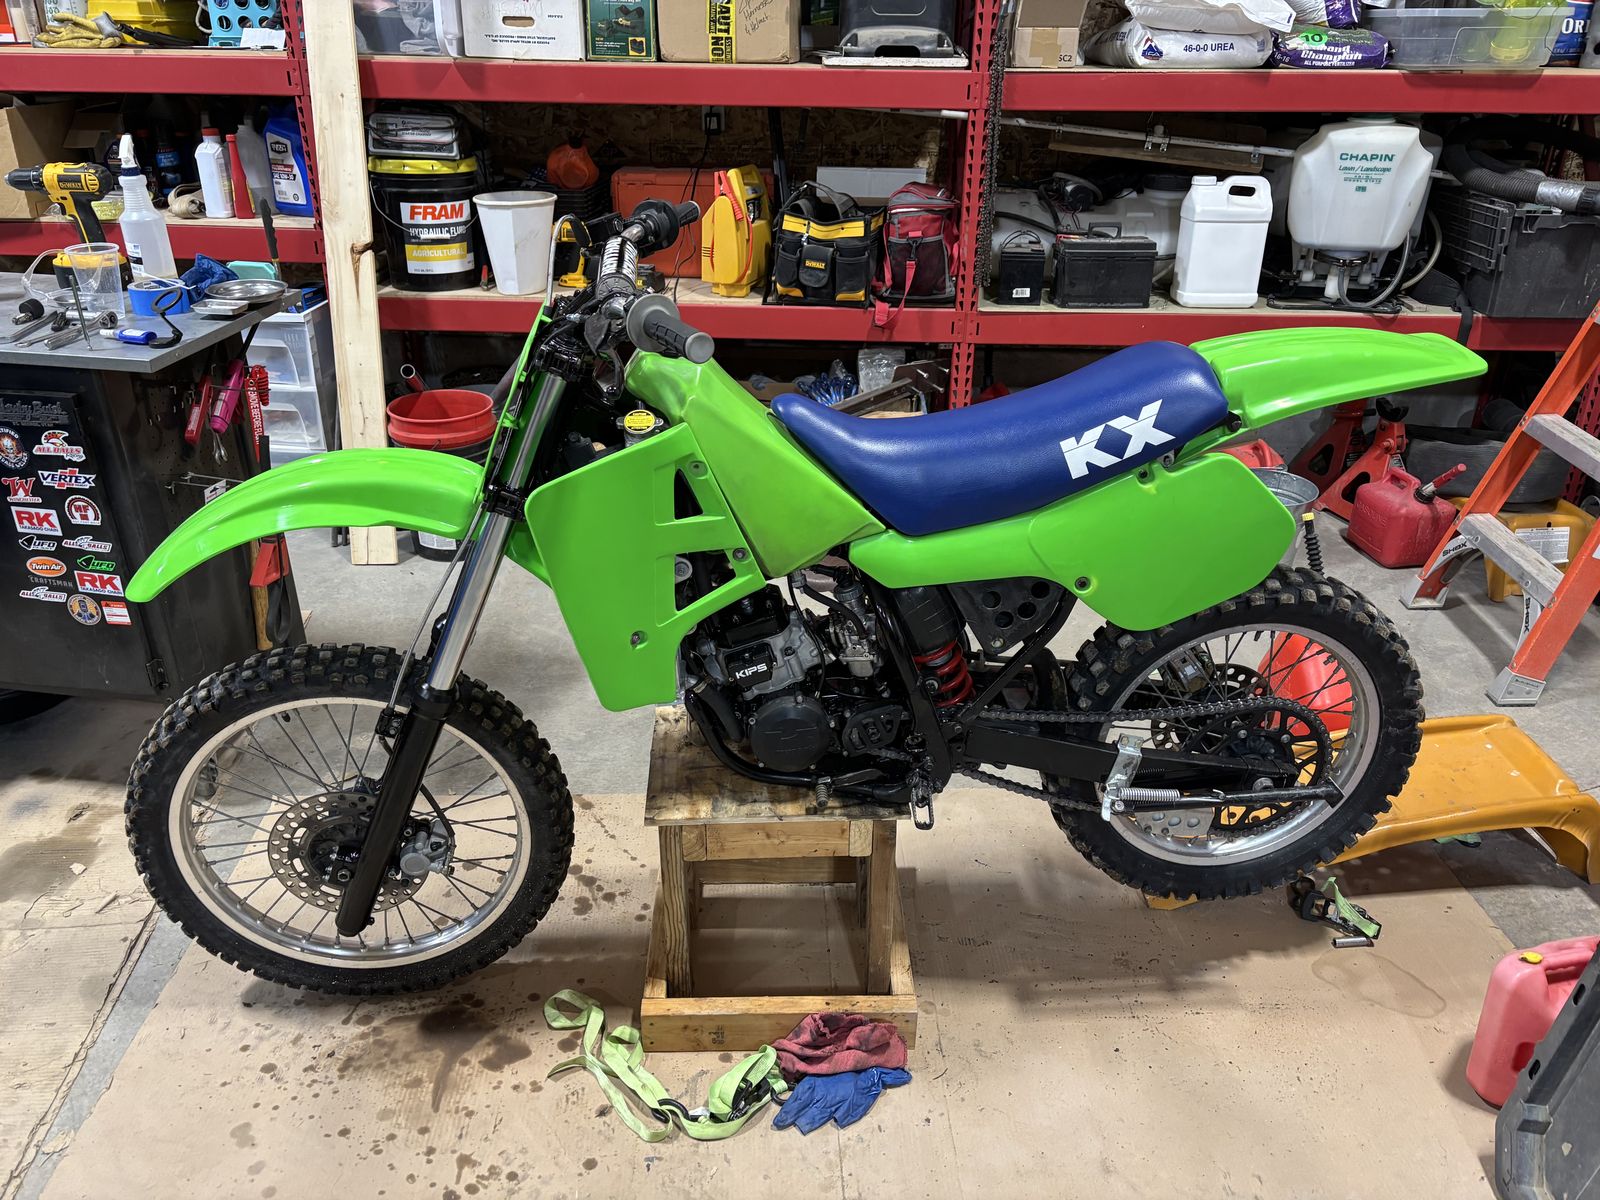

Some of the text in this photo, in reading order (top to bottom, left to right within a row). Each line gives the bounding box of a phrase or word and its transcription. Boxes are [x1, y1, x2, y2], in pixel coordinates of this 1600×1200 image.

[1300, 33, 1324, 43] 10
[1183, 42, 1235, 53] 46-0-0 UREA
[1058, 54, 1072, 62] SC2
[1339, 152, 1394, 162] CHAPIN
[1360, 165, 1392, 174] Landscape
[409, 203, 464, 221] FRAM
[409, 227, 449, 237] HYDRAULIC
[412, 247, 465, 257] AGRICULTURAL
[1060, 399, 1177, 480] KX
[40, 472, 94, 485] VERTEX
[1, 477, 36, 497] W
[15, 510, 57, 528] RK
[33, 540, 56, 548] UFO
[76, 572, 120, 591] RK
[735, 663, 768, 679] KIPS
